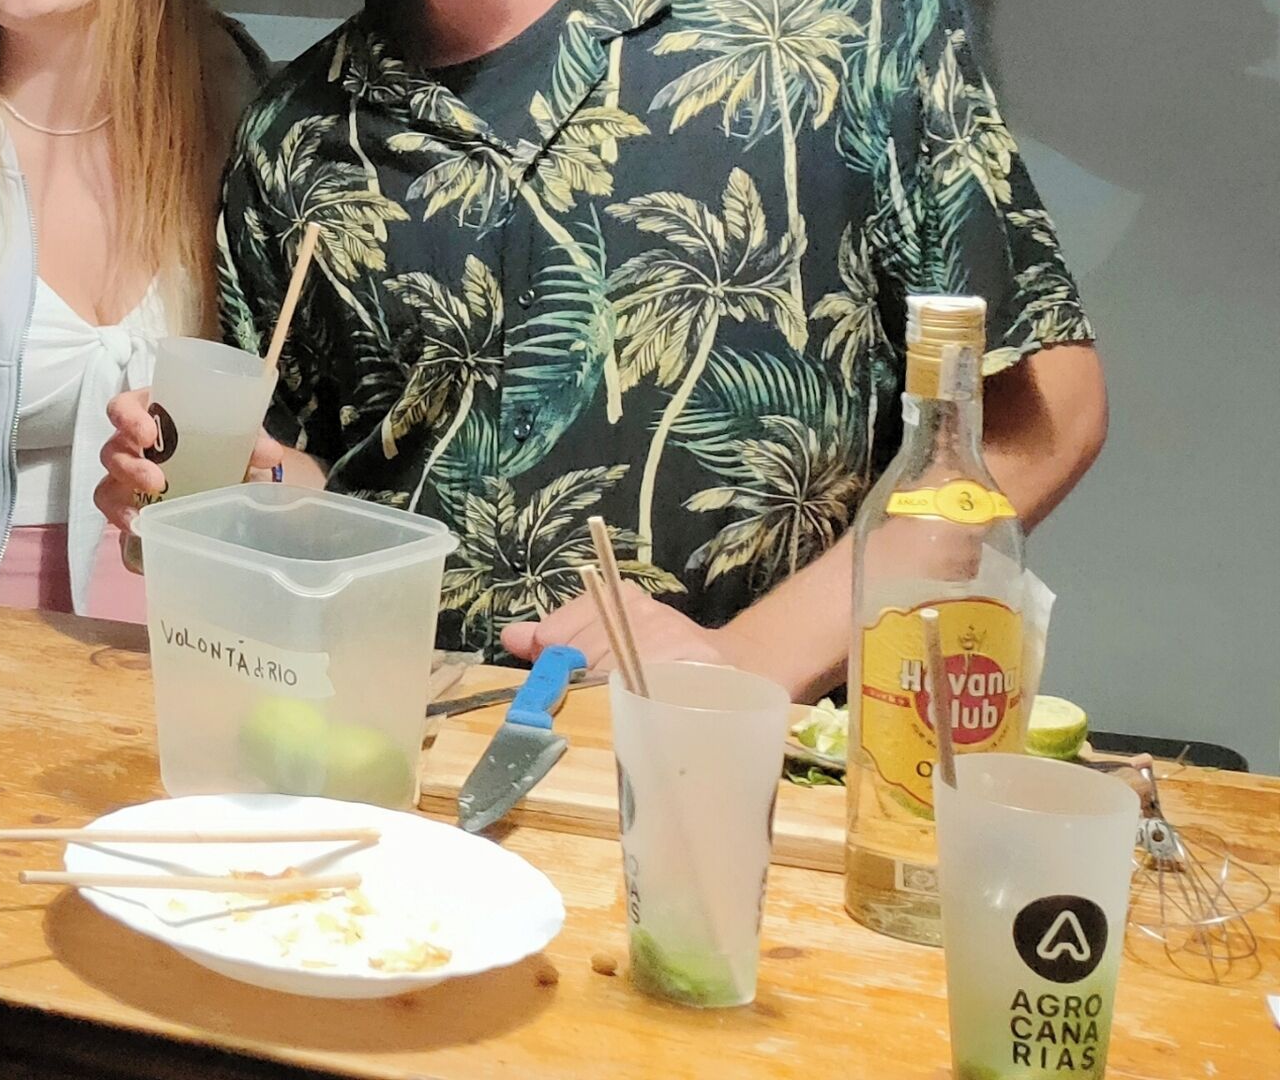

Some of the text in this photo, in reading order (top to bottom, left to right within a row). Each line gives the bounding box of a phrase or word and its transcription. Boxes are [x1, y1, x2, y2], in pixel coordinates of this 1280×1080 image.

[958, 490, 975, 512] 3
[1010, 988, 1103, 1019] AGRO
[1010, 1015, 1099, 1045] CANA
[1012, 1041, 1096, 1071] RIAS
